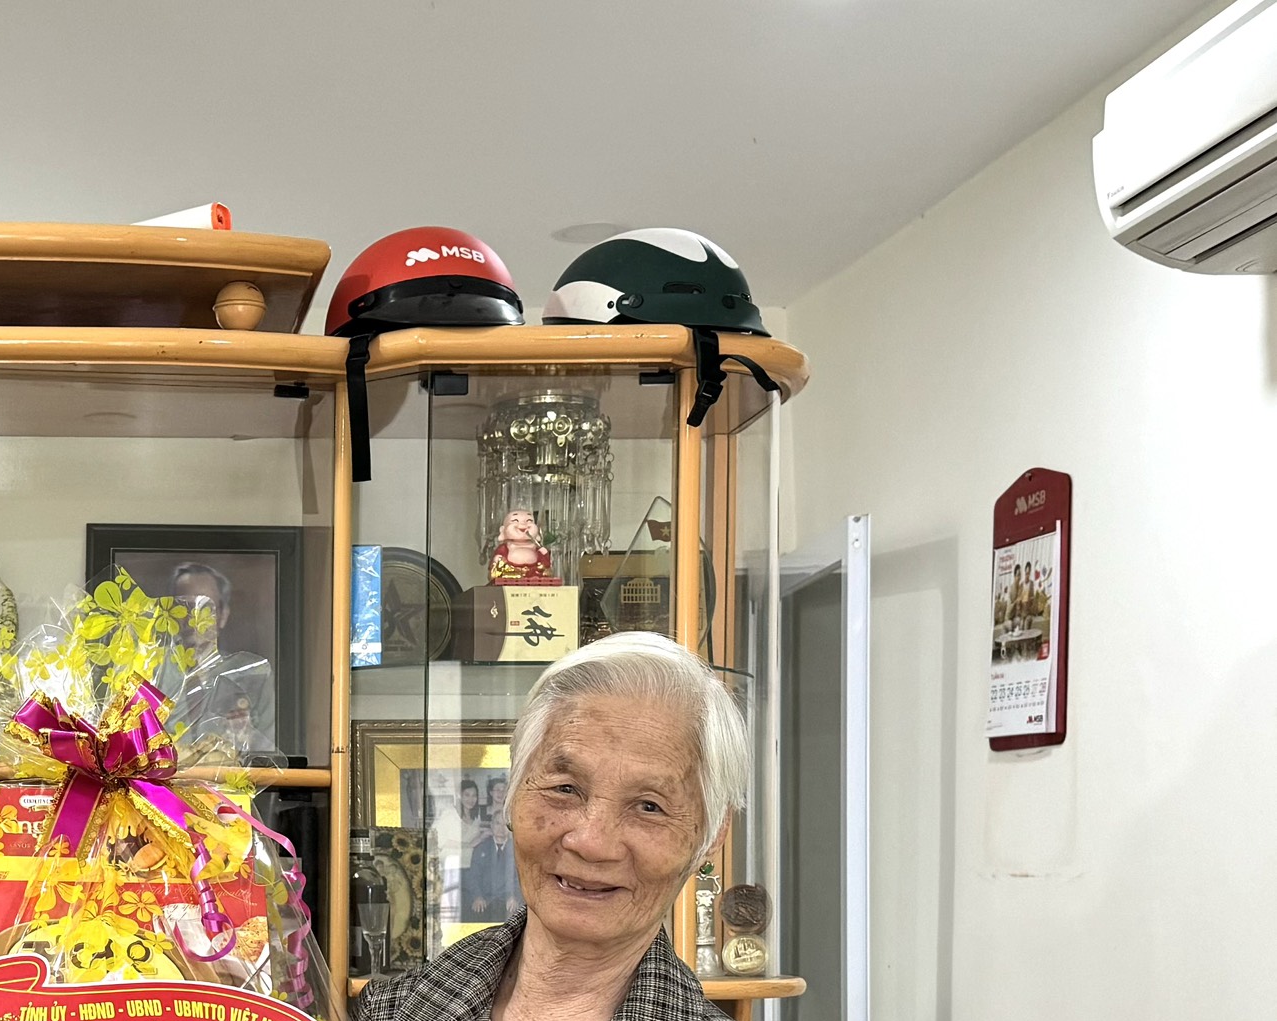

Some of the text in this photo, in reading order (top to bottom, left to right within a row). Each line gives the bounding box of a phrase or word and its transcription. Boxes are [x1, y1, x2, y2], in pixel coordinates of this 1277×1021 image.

[441, 245, 485, 264] MSB
[1027, 489, 1046, 509] MSB
[79, 1001, 115, 1021] HĐND
[126, 999, 163, 1018] UBND
